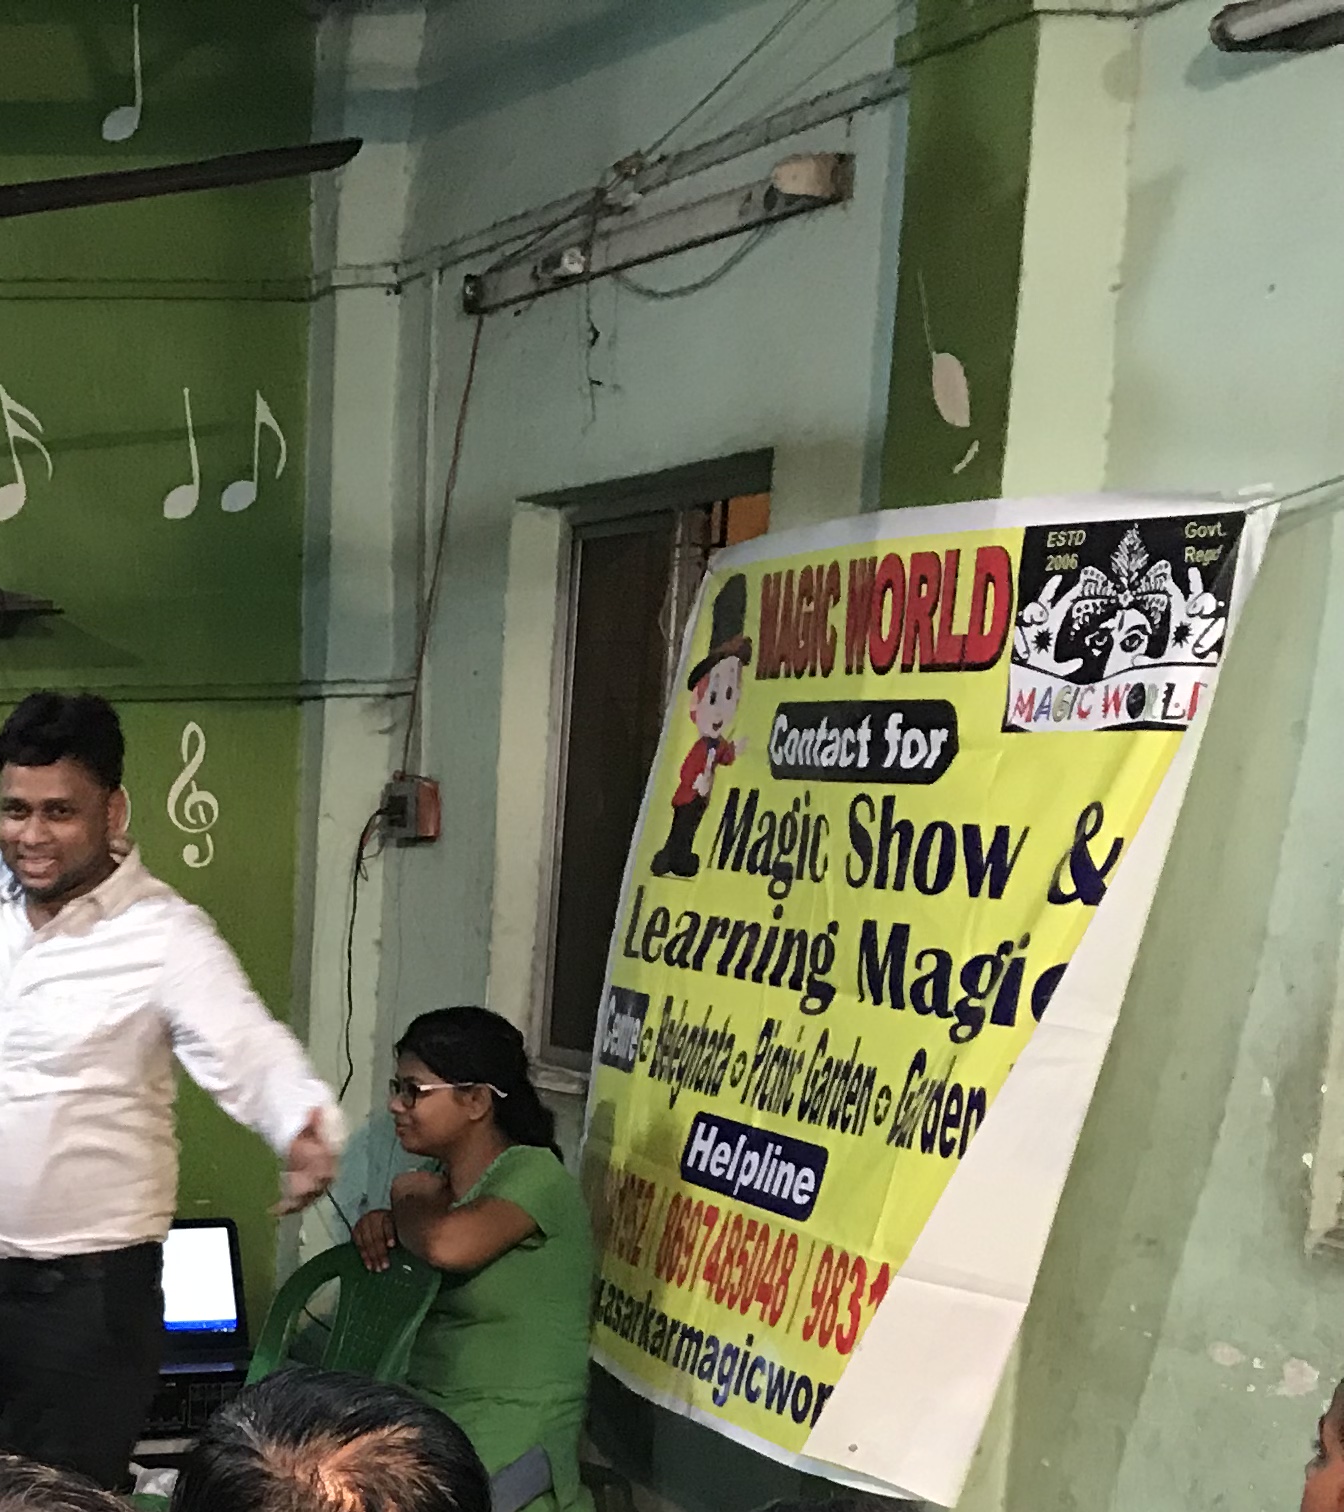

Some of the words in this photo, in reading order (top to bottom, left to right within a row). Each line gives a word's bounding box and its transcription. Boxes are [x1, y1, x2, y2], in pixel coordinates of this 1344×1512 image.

[1047, 529, 1086, 548] ESTD
[755, 560, 841, 680] MAGIC
[845, 546, 1013, 676] WORLD
[770, 713, 872, 769] Contact
[882, 712, 949, 769] for
[1012, 684, 1096, 723] MAGIC
[707, 787, 830, 900] Magic
[845, 793, 1030, 899] Show
[1047, 801, 1124, 906] &
[623, 884, 840, 1015] Learning
[740, 1017, 806, 1117] Picnic
[797, 1027, 878, 1137] Garden
[687, 1121, 816, 1206] Helpline
